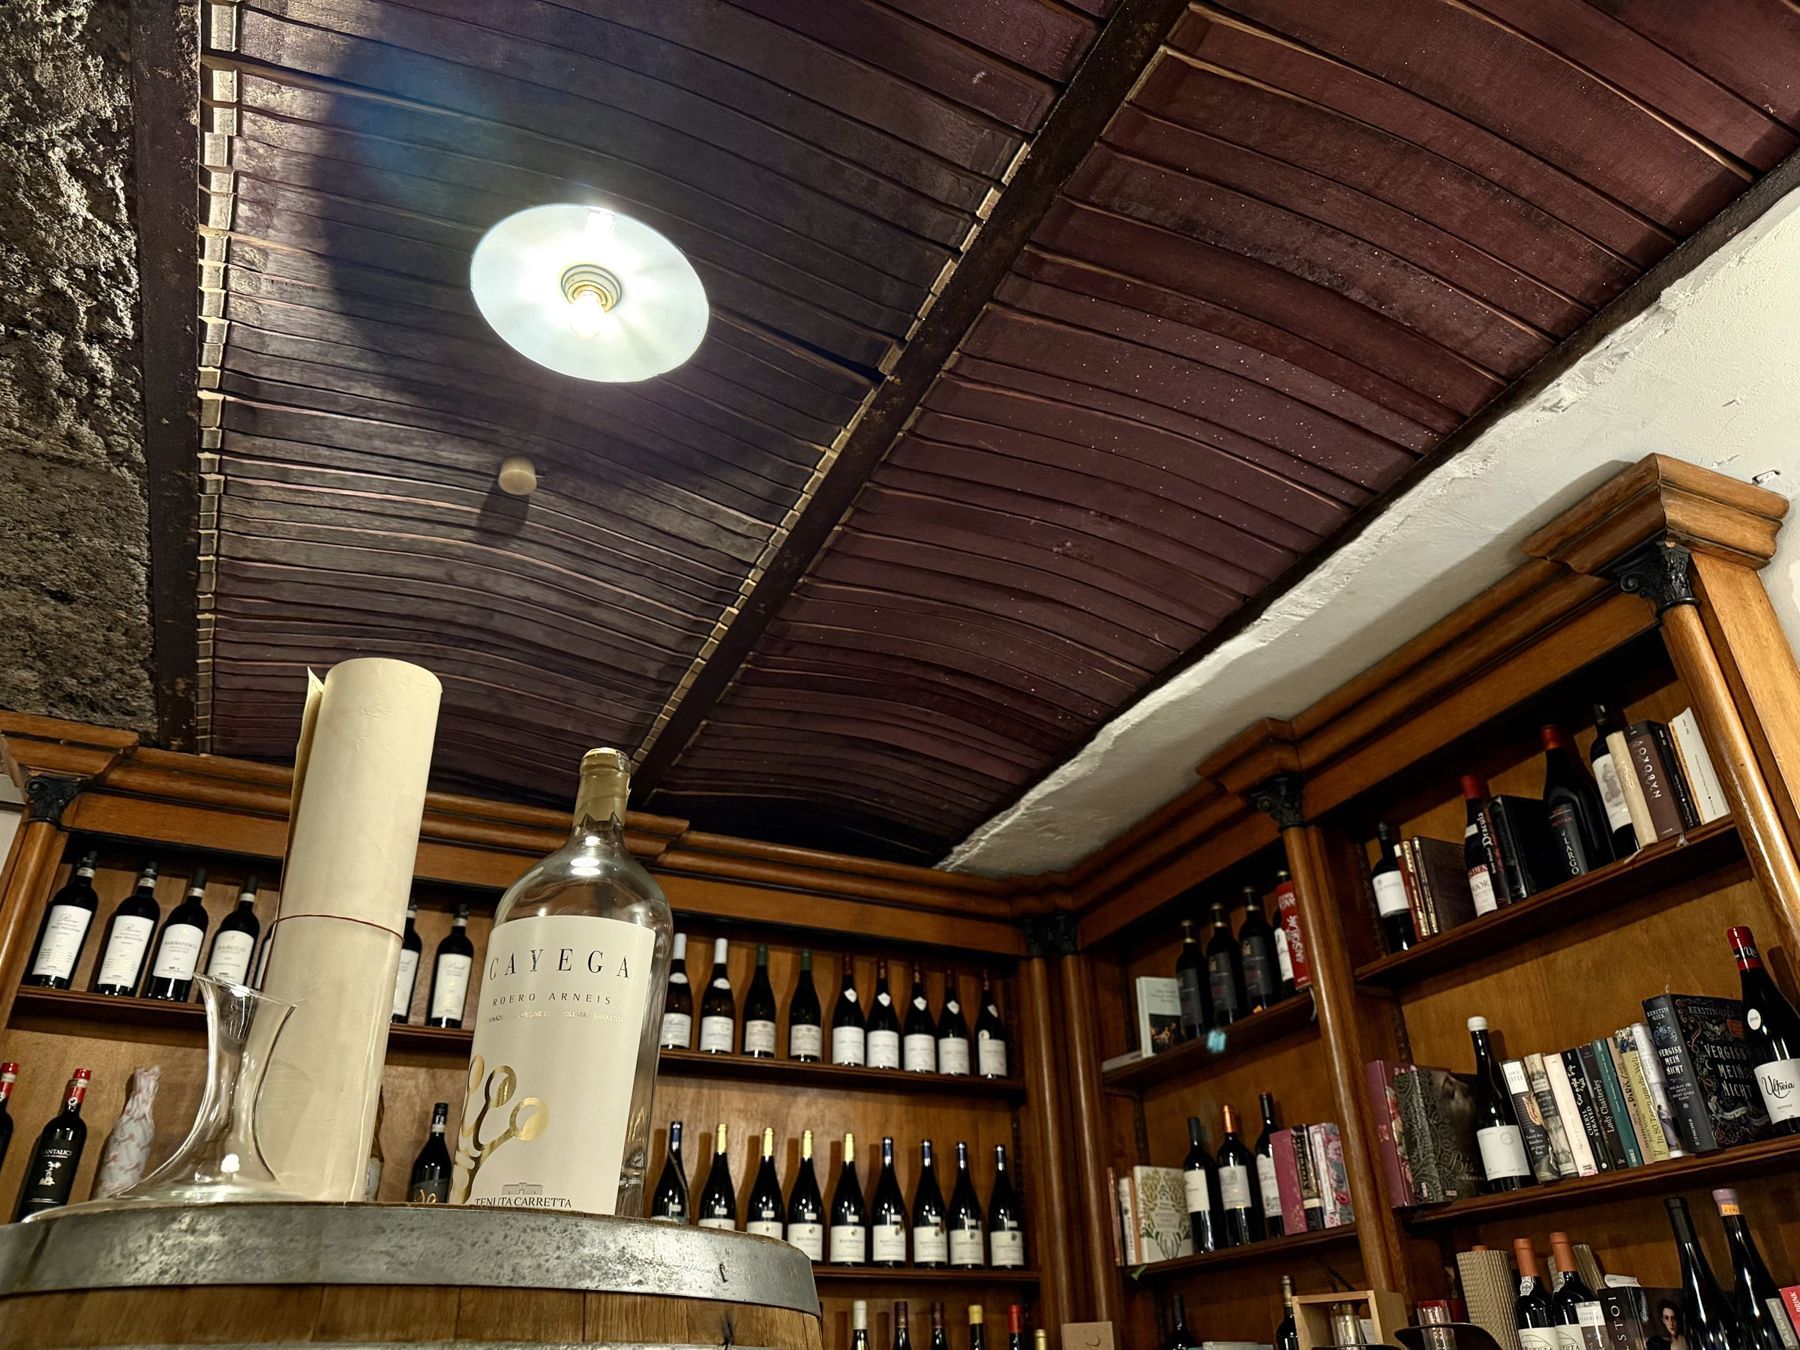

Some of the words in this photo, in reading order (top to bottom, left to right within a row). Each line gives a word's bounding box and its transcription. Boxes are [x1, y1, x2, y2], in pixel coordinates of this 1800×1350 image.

[1634, 740, 1661, 799] NABOKOV
[1477, 811, 1494, 846] Dracula
[489, 948, 630, 981] CAYEGA
[492, 993, 536, 1007] ROERO
[548, 992, 611, 1005] ARNEIS
[1658, 1045, 1682, 1057] VERGISS
[1664, 1054, 1680, 1065] MEIN
[1703, 1043, 1747, 1060] VERGISS
[1666, 1064, 1684, 1076] NICHT
[1717, 1064, 1745, 1080] MEIN
[1594, 1079, 1609, 1115] Chatterley
[1721, 1080, 1753, 1099] NICHT
[1582, 1109, 1594, 1136] CHERYL
[1587, 1106, 1600, 1137] STRAYED
[1605, 1115, 1615, 1133] Lady
[1652, 1123, 1660, 1135] 80
[475, 1197, 512, 1206] TENUTA
[513, 1197, 572, 1208] CARRETTA
